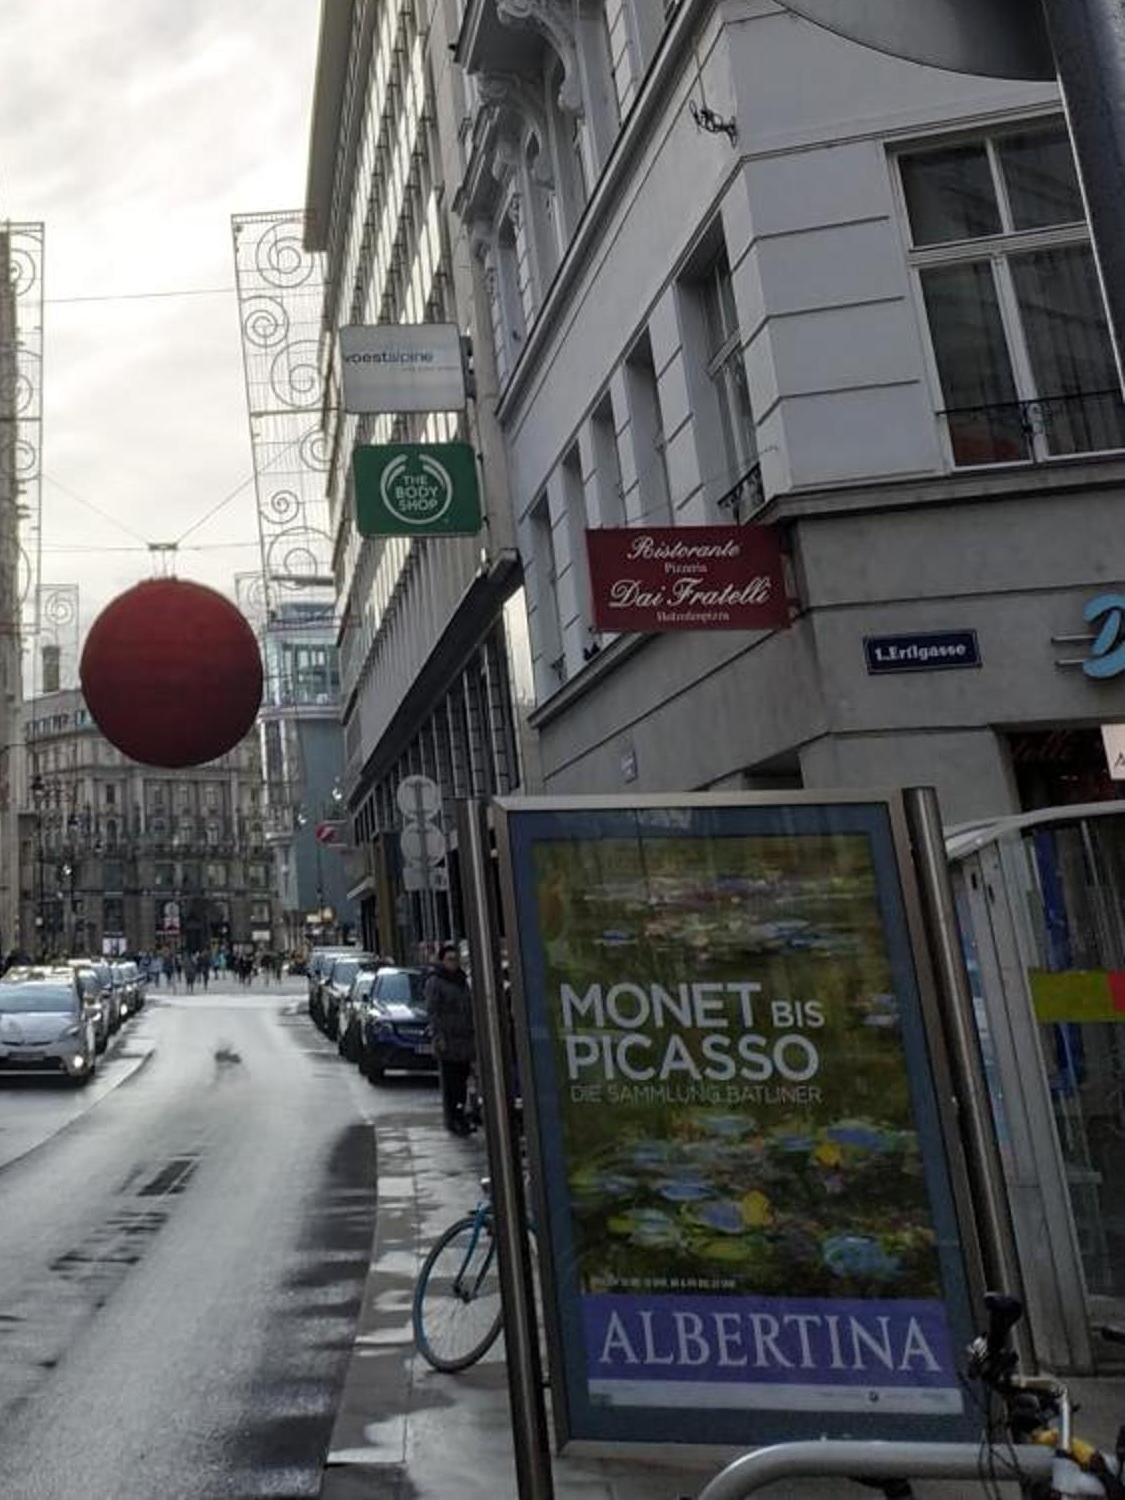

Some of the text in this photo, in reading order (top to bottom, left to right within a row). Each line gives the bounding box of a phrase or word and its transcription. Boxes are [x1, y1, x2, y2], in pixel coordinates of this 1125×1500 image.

[343, 350, 434, 364] voestalpine
[403, 475, 428, 485] THE
[396, 486, 438, 499] BODY
[398, 499, 438, 511] SHOP
[627, 535, 741, 560] Ristorante
[609, 577, 772, 607] Dai Fratelli
[560, 982, 825, 1029] MONET BIS
[566, 1033, 820, 1082] PICASSO
[571, 1085, 822, 1104] DIE SAMMLUNG BATLINER
[599, 1310, 943, 1372] ALBERTINA
